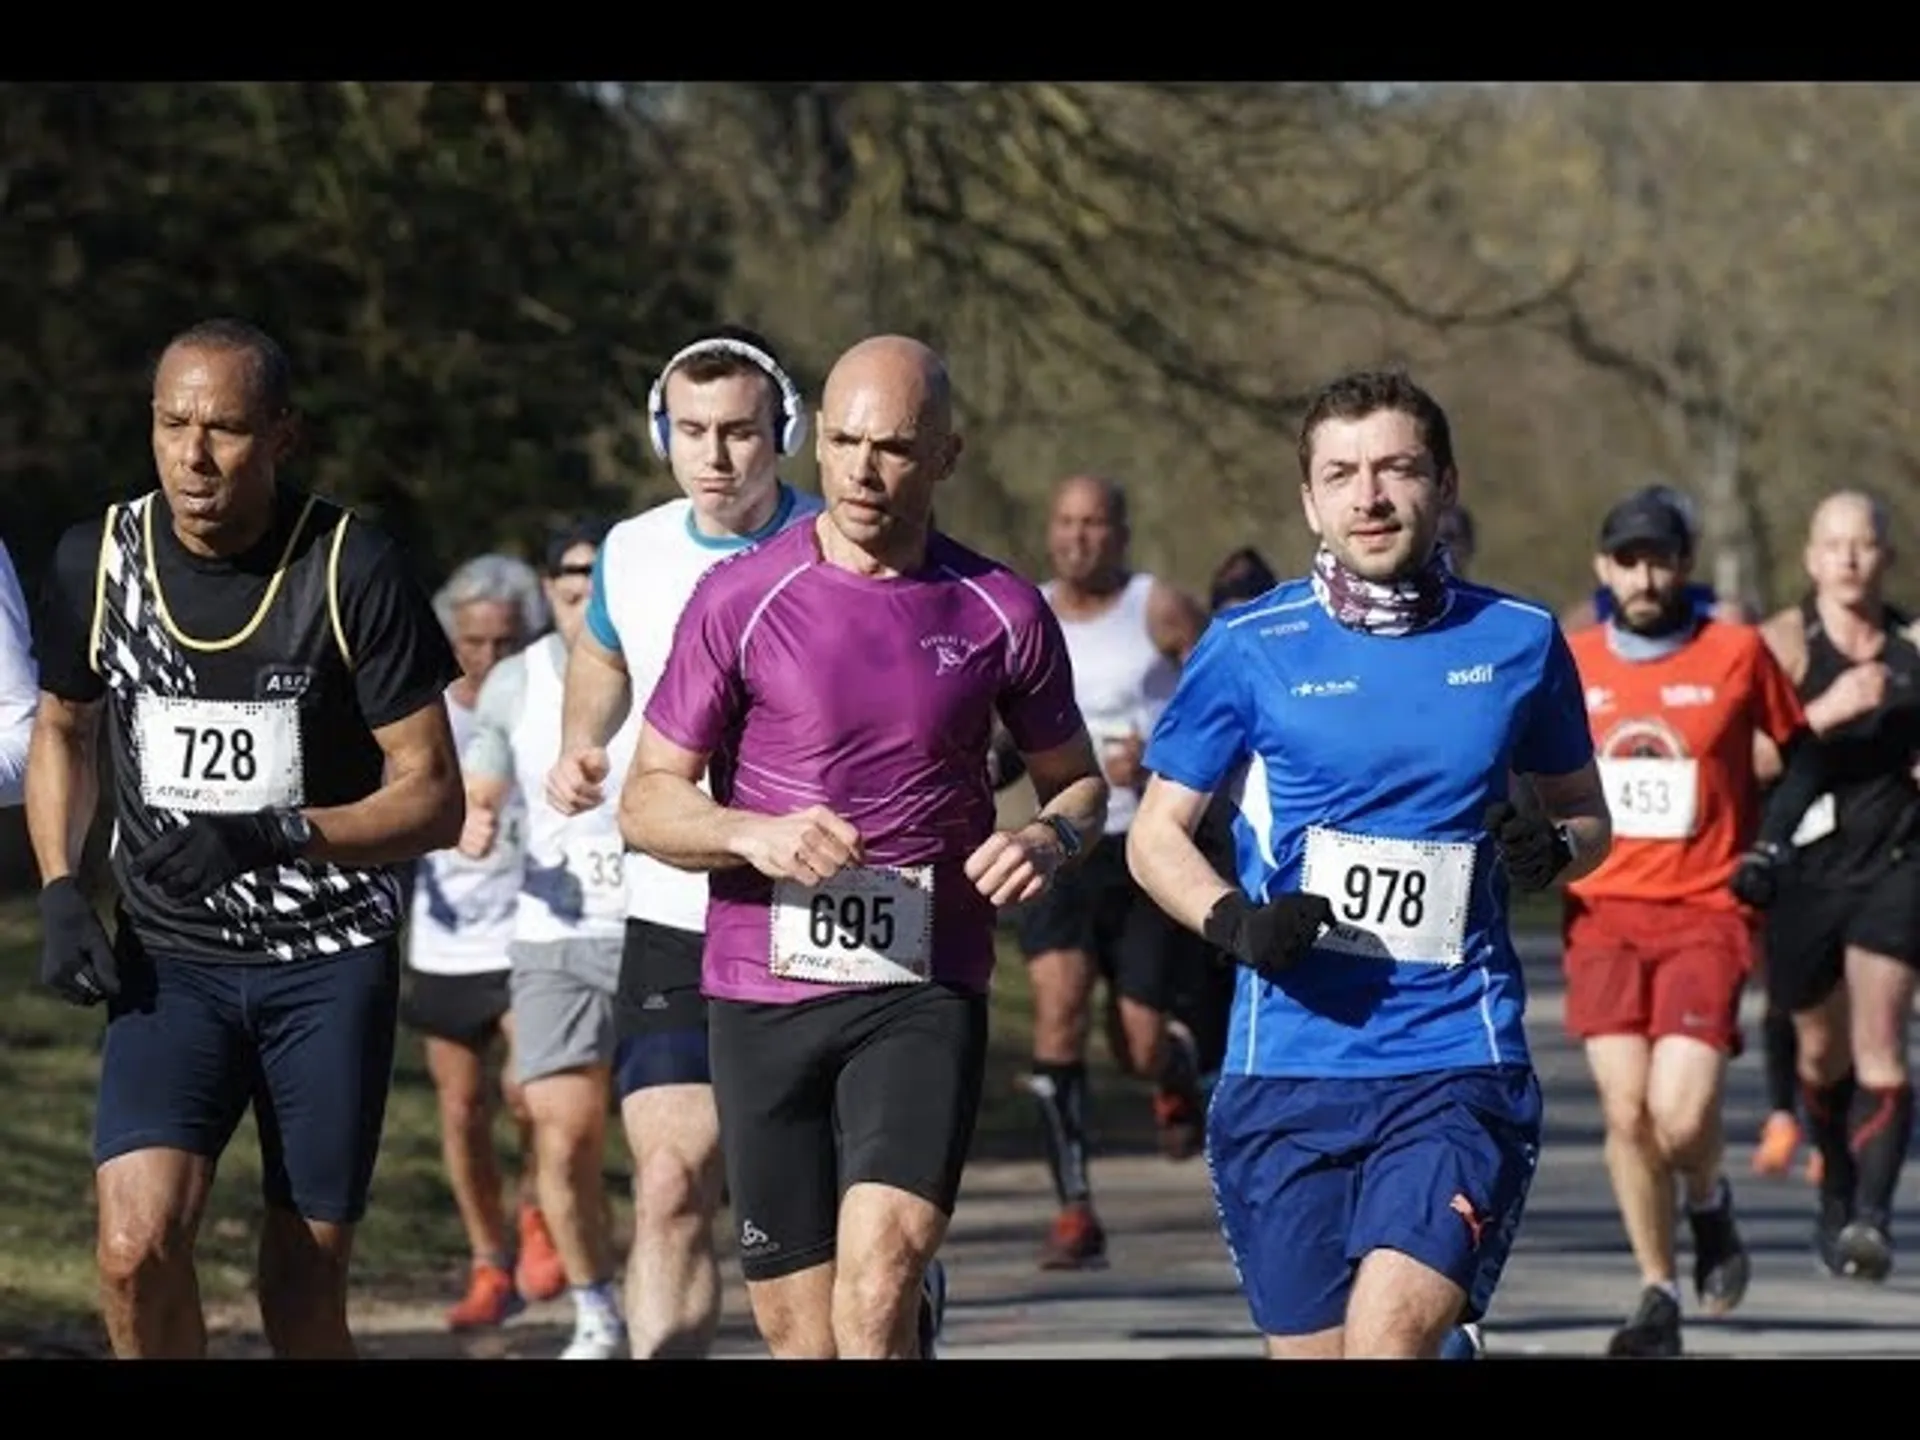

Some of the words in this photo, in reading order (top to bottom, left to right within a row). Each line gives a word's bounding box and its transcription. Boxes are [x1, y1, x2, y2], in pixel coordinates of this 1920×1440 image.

[174, 726, 256, 782] 728
[1620, 780, 1671, 815] 453
[810, 894, 894, 950] 695
[1343, 864, 1427, 928] 978
